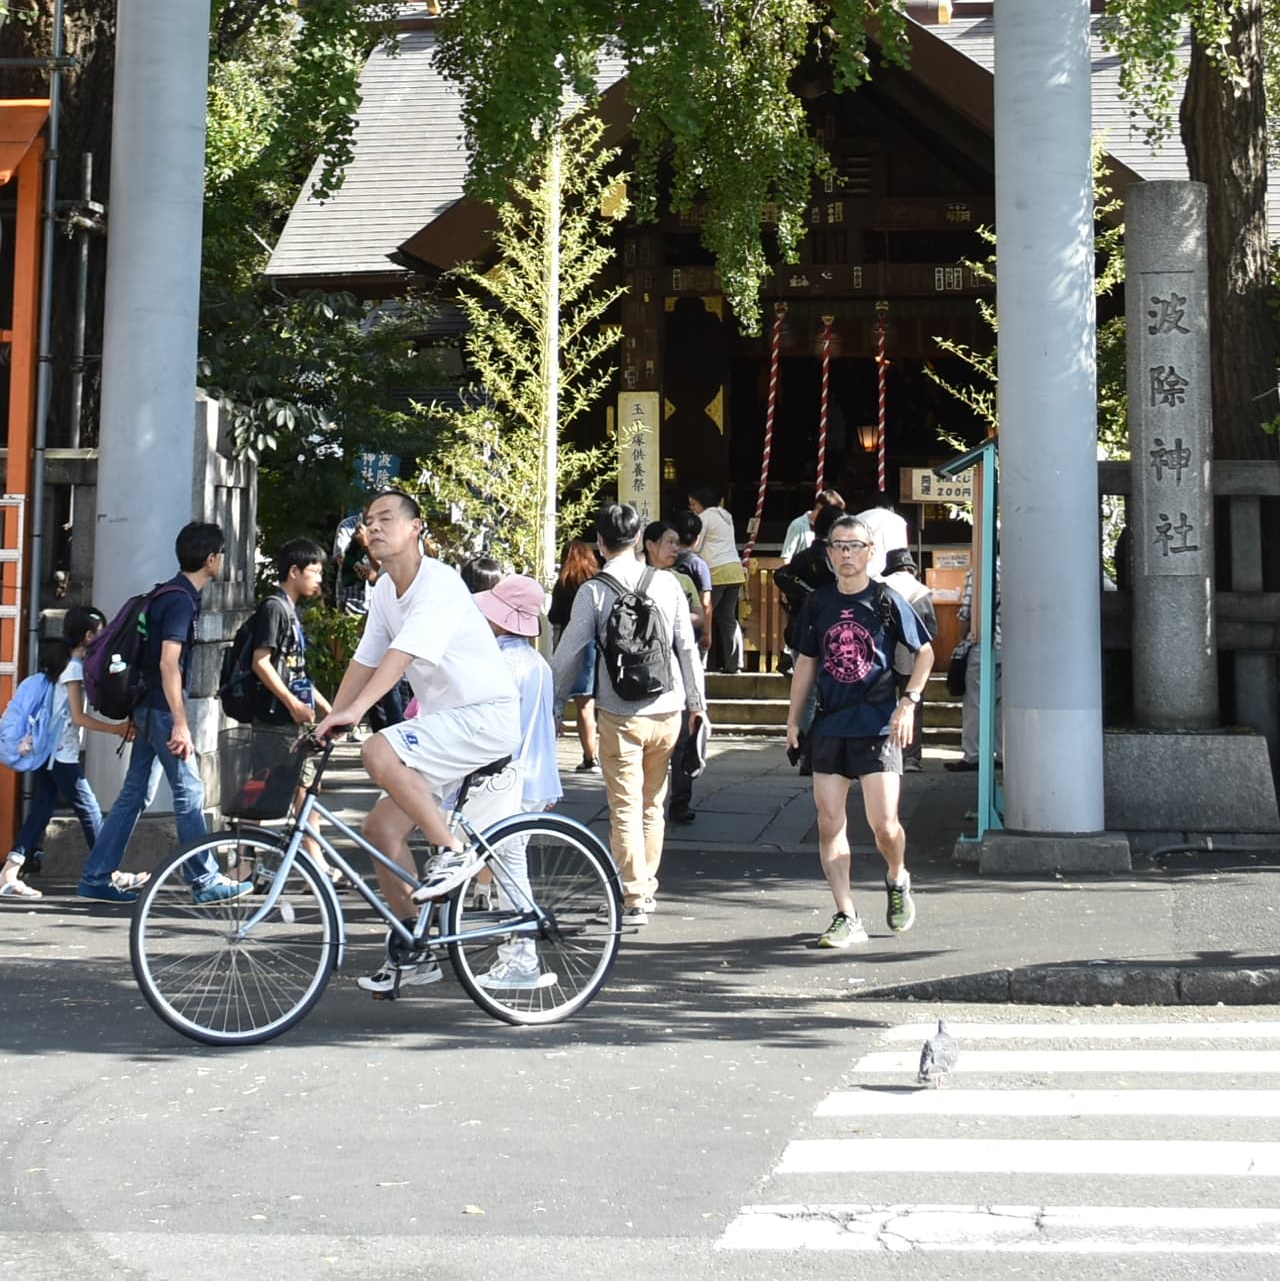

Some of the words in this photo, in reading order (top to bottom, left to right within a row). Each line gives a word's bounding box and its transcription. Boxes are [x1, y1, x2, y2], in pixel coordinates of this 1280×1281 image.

[631, 403, 646, 493] 玉塚供養祭
[1148, 293, 1200, 559] 波除神社
[937, 487, 971, 497] 200円
